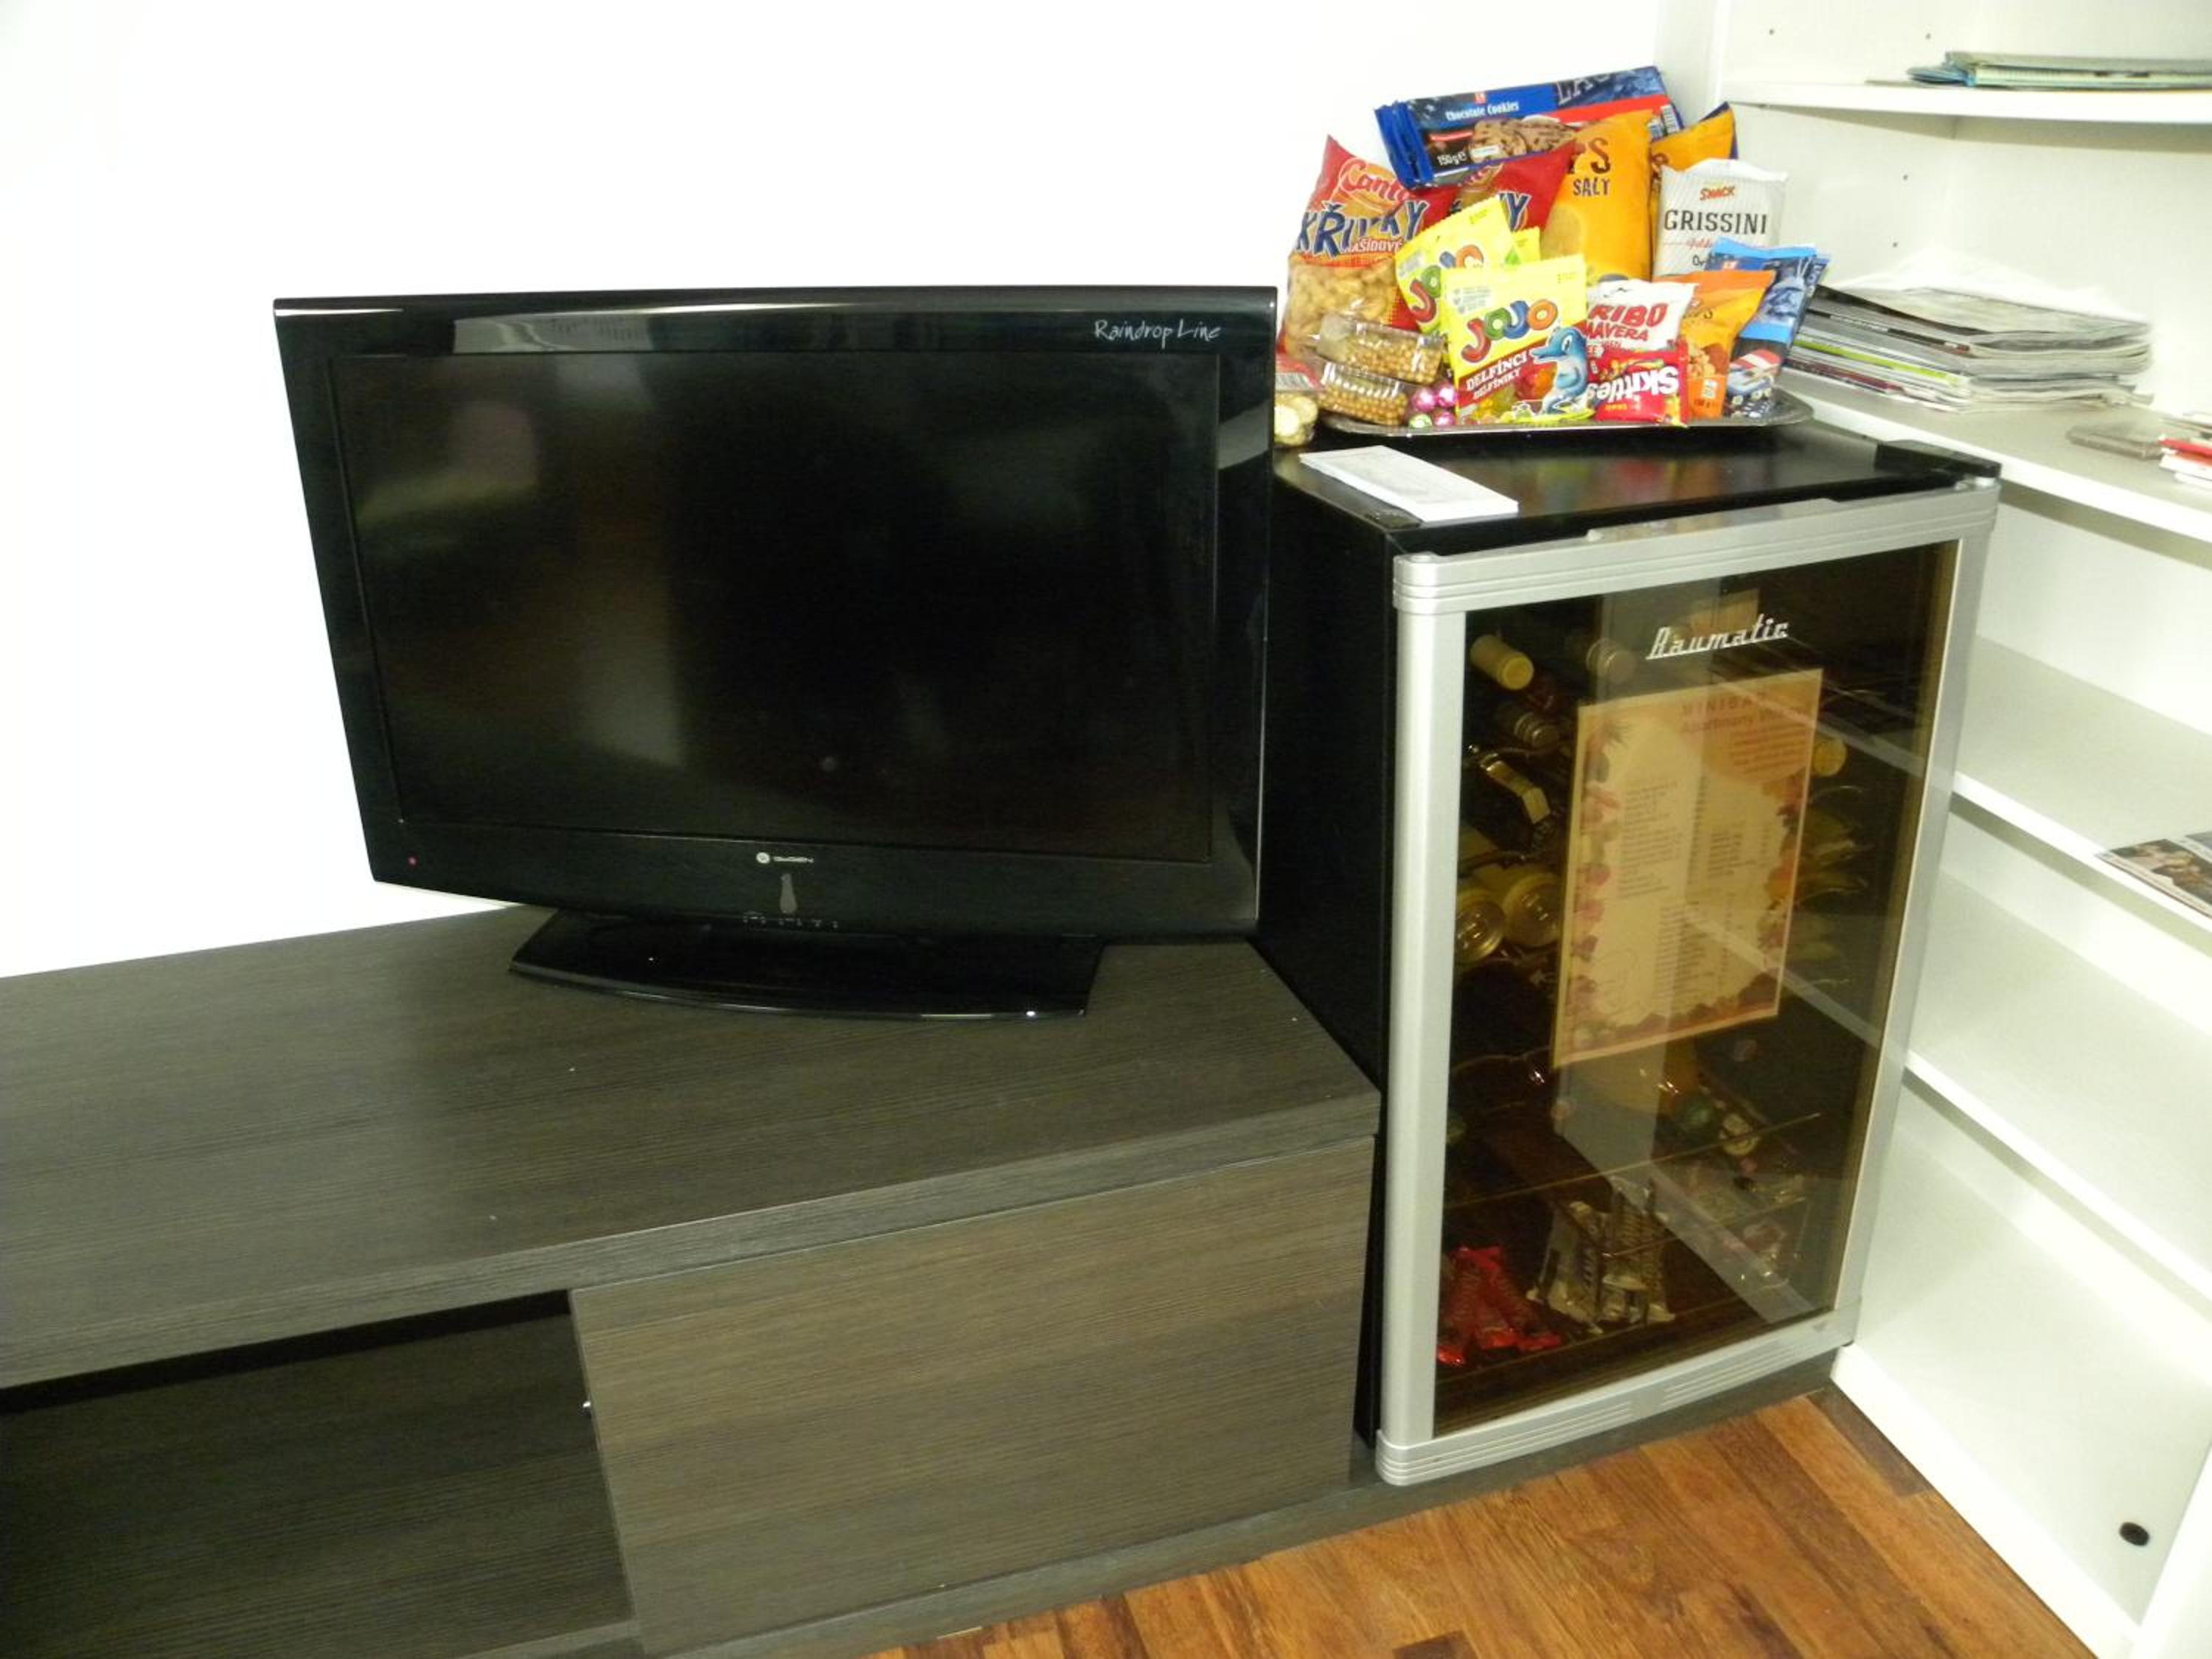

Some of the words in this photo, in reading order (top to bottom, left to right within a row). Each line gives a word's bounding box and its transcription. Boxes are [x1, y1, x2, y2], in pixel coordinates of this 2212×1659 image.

[1573, 176, 1610, 197] SALT
[1663, 209, 1767, 234] GRISSINI
[1095, 319, 1173, 349] Raindrop
[1178, 319, 1221, 341] Line
[1461, 298, 1558, 363] JOJO
[1587, 366, 1679, 403] Skittles
[1645, 613, 1790, 661] Baumatic
